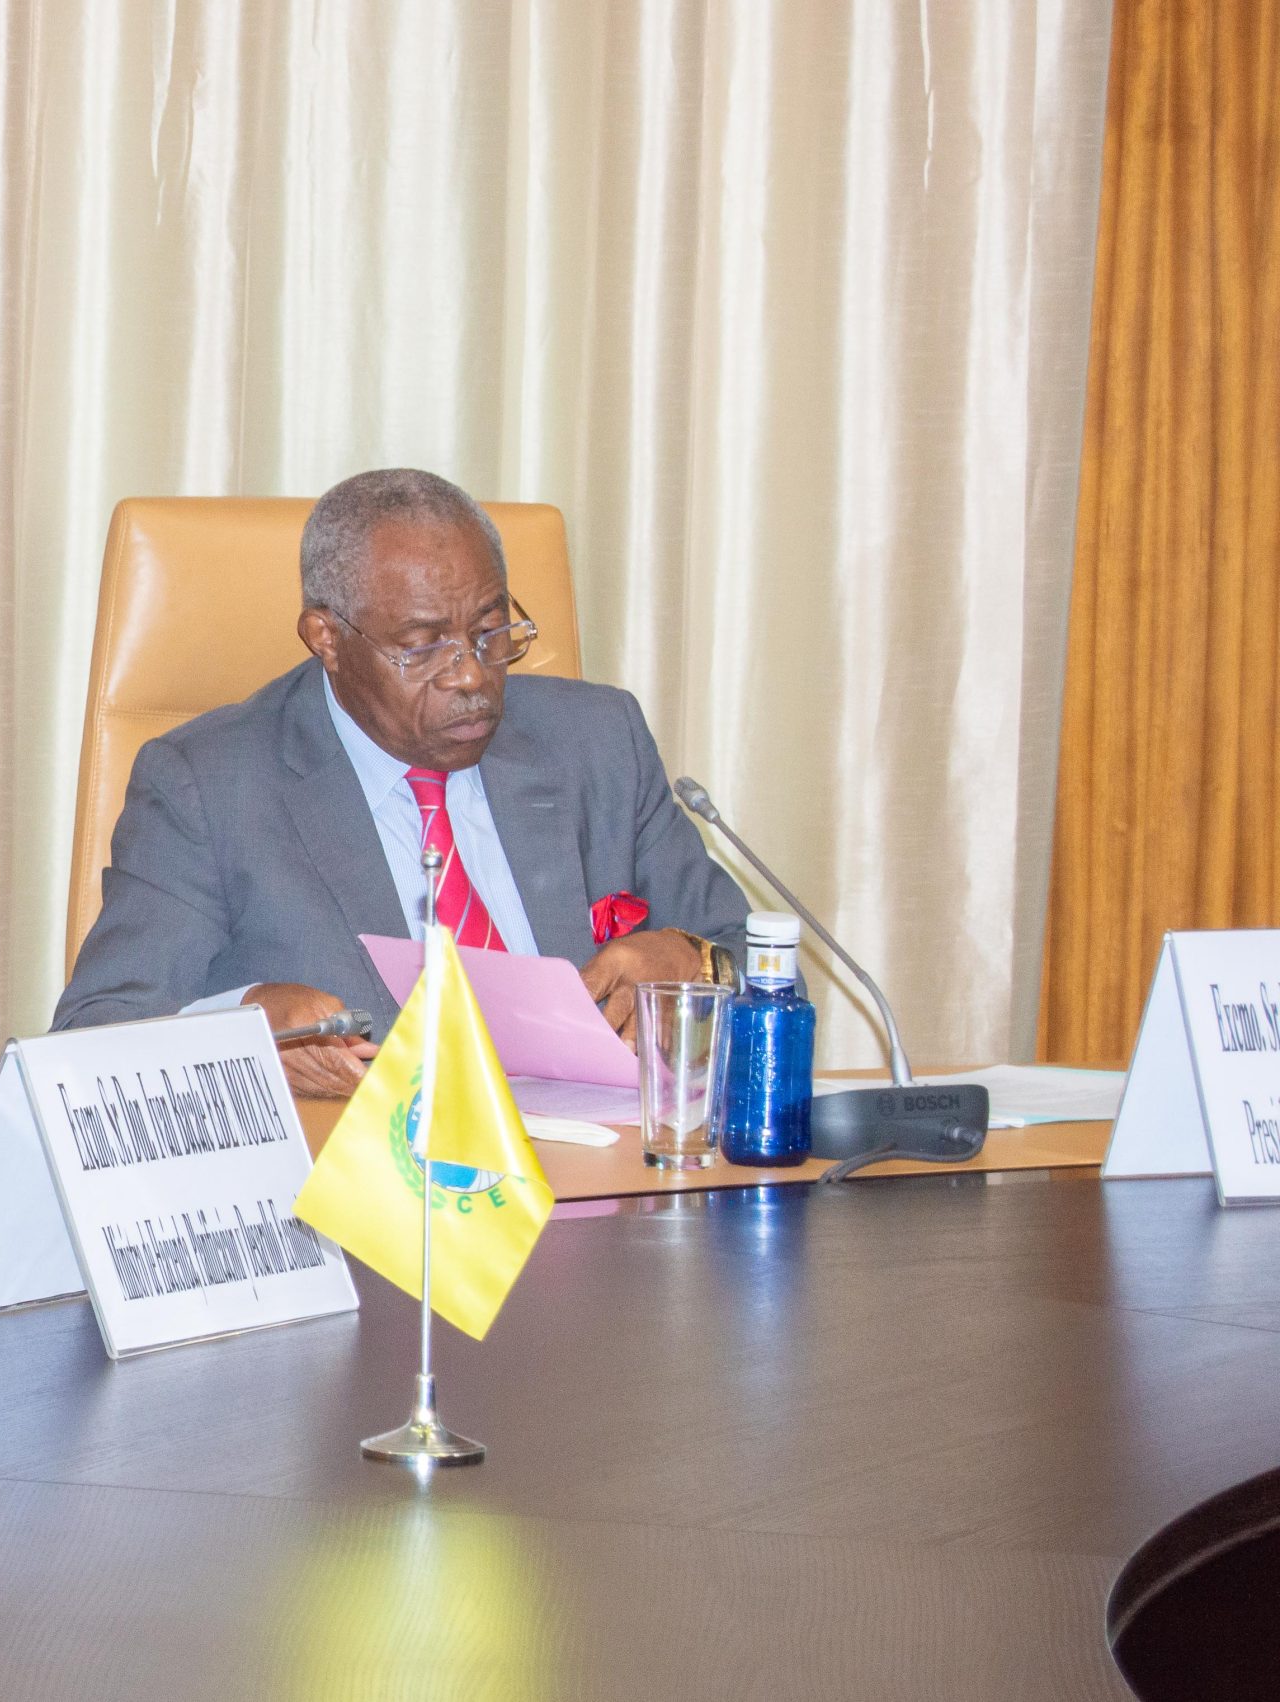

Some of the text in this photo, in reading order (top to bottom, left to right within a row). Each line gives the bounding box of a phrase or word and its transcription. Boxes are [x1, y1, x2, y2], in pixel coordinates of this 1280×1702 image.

[1210, 983, 1266, 1052] Excmo.
[56, 1056, 288, 1172] Excmo. Sr. Don. Ivan Bacale EBE MOLINA
[903, 1094, 960, 1112] BOSCH
[1242, 1096, 1280, 1164] Presi
[101, 1224, 154, 1302] Ministro
[135, 1220, 164, 1297] de
